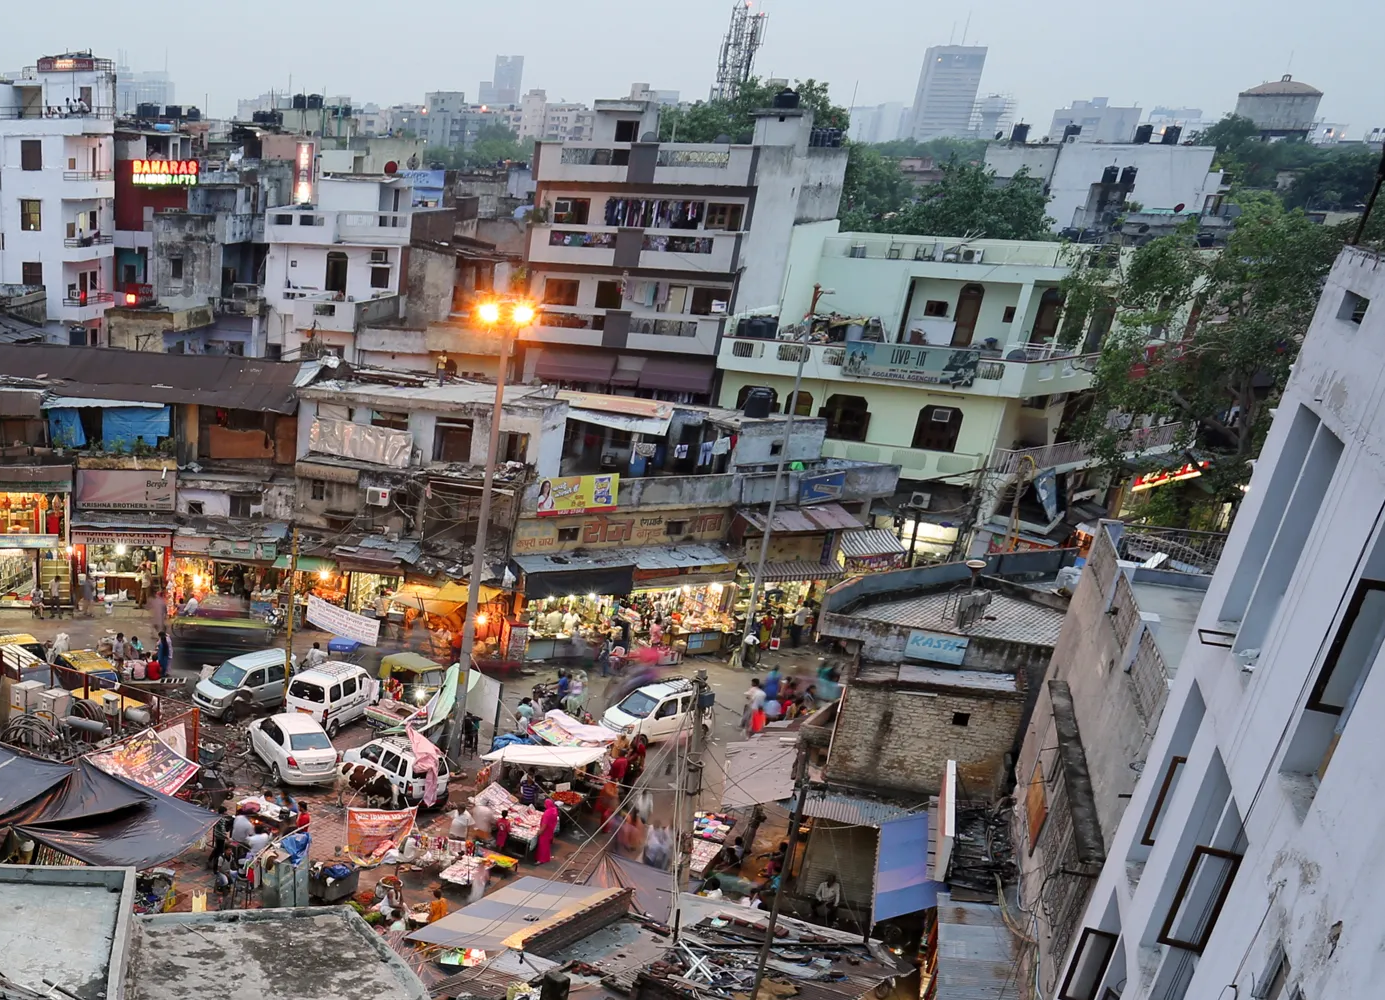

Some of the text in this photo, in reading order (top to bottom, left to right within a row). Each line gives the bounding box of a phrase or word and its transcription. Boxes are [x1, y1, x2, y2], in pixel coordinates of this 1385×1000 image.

[132, 160, 197, 174] BANARAS
[132, 173, 197, 185] HANDICRAFTS
[871, 371, 905, 380] AGGARWAL
[907, 374, 938, 382] AGENCIES
[145, 479, 169, 489] Berger
[82, 502, 148, 510] KRISHNA BROTHERS
[85, 537, 115, 545] PAINTS
